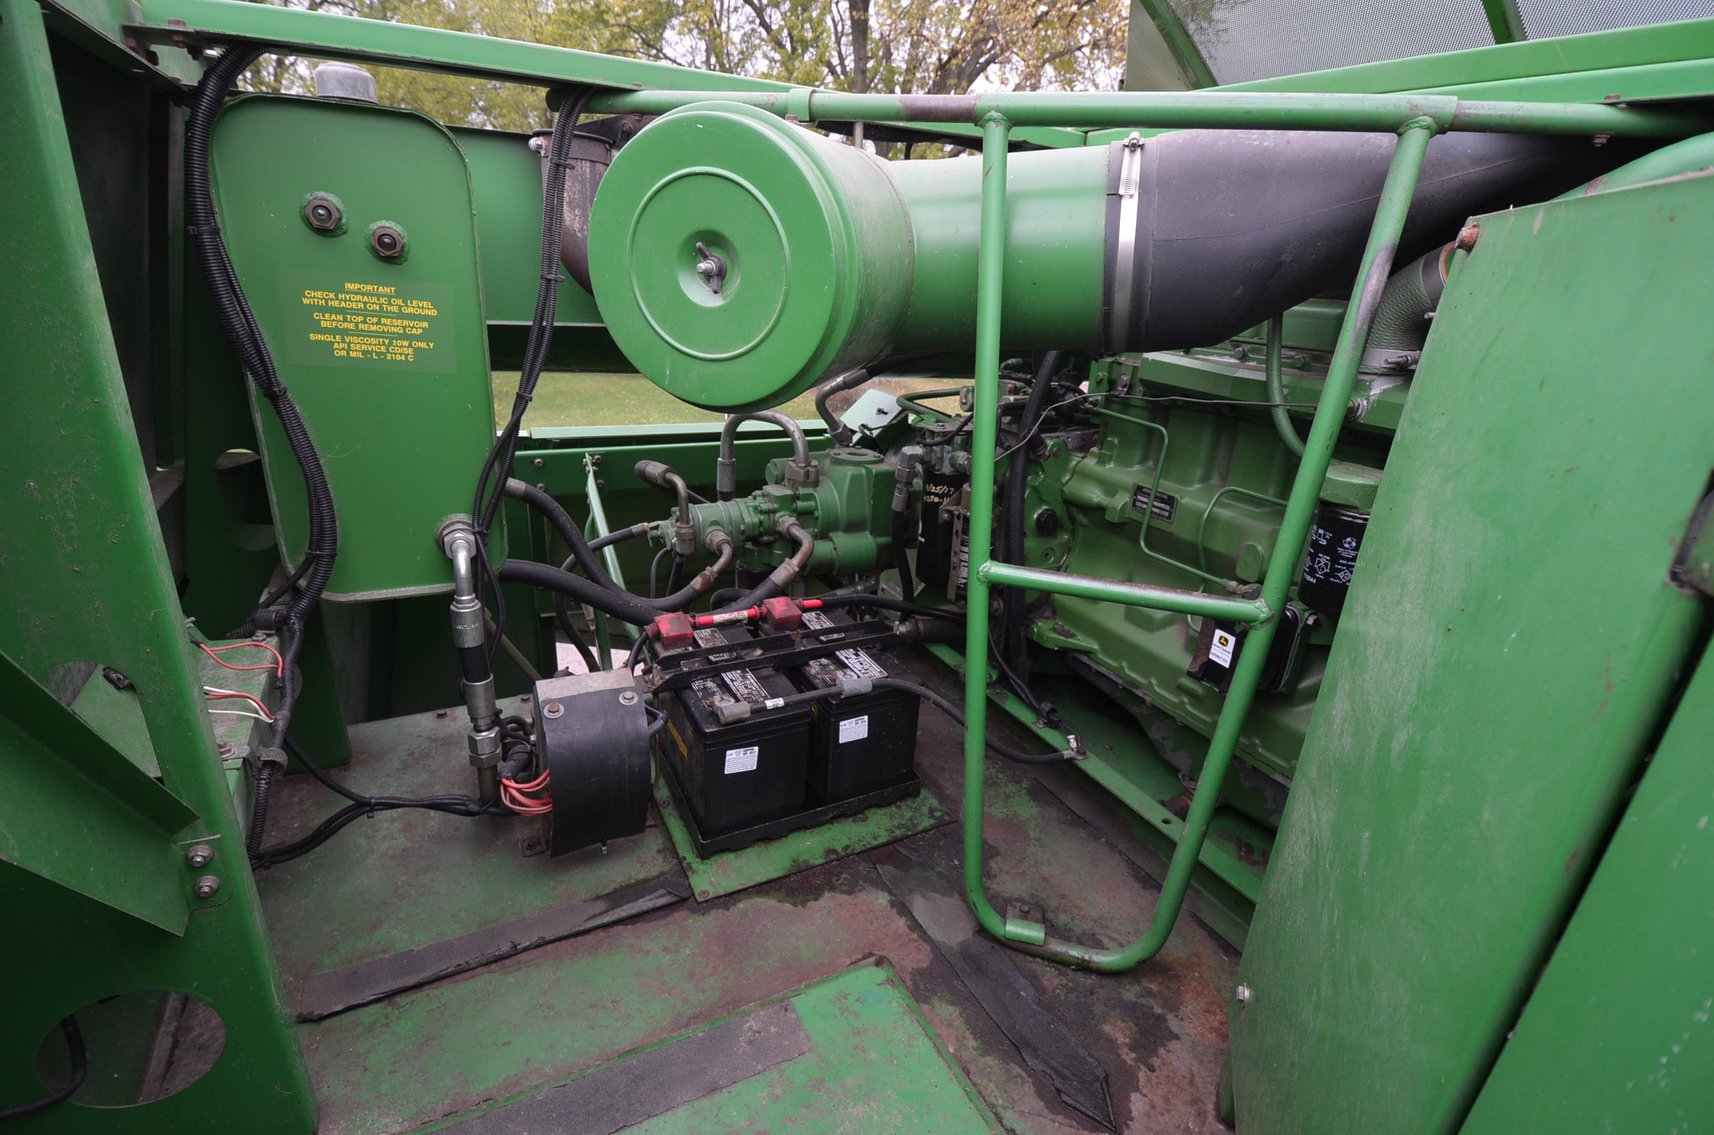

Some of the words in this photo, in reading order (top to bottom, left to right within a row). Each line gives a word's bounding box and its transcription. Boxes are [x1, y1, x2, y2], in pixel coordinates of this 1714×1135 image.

[345, 283, 396, 294] IMPORTANT
[305, 290, 336, 299] CHECK
[338, 293, 388, 304] HYDRAULIC
[407, 300, 434, 308] LEVEL
[302, 298, 325, 306] WITH
[328, 300, 364, 309] HEADER
[402, 307, 437, 316] GROUND
[313, 312, 344, 321] CLEAN
[381, 318, 428, 328] RESERVOIR
[321, 321, 356, 329] BEFORE
[358, 324, 403, 333] REMOVING
[309, 334, 342, 342] SINGLE
[345, 336, 389, 345] VISCOSITY
[333, 342, 348, 350] API
[350, 344, 387, 352] SERVICE
